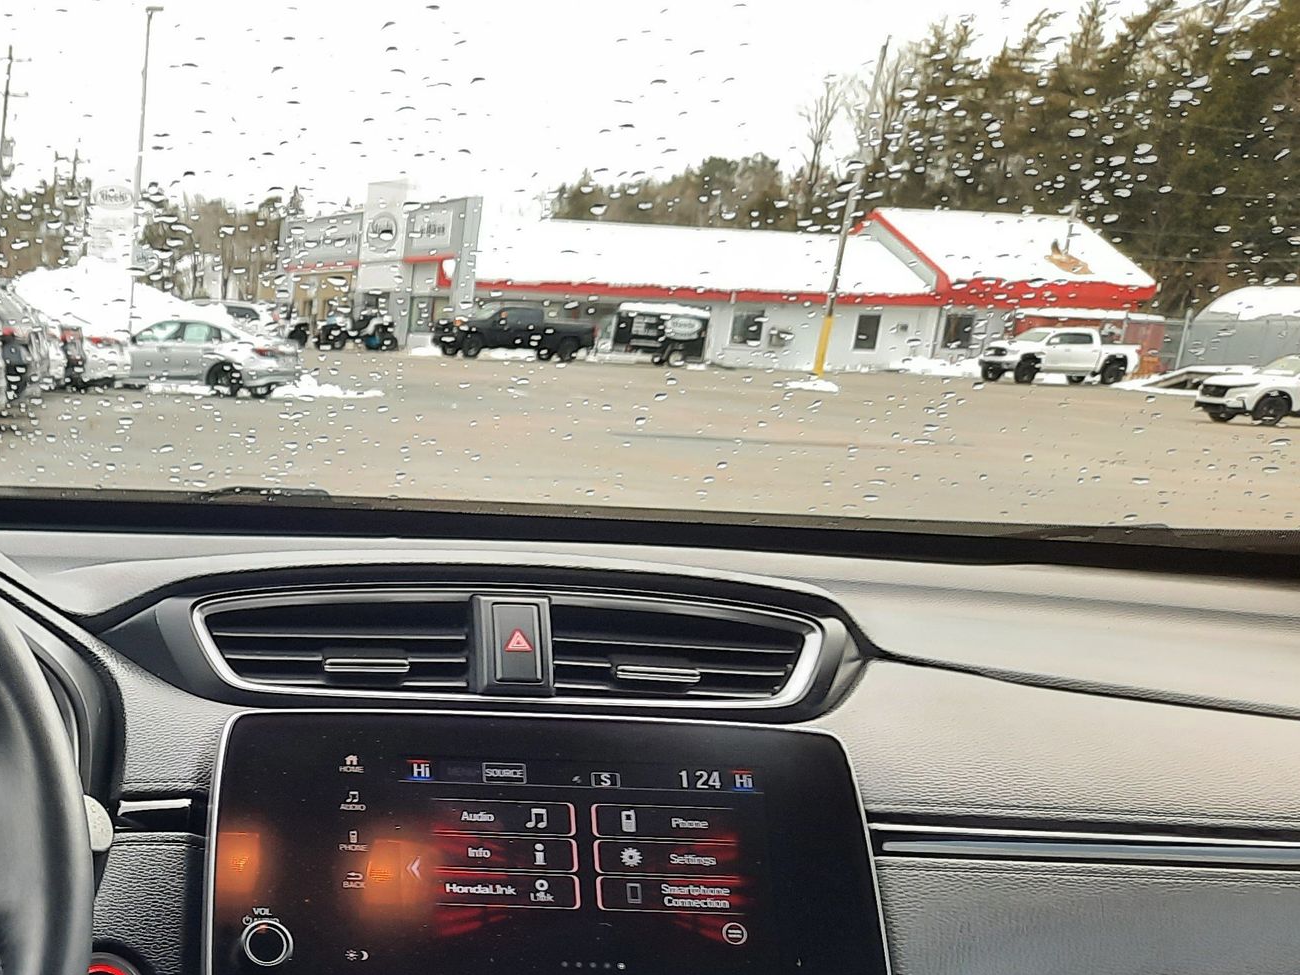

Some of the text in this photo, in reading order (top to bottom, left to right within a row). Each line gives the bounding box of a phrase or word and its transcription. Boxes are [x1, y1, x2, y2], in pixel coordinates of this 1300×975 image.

[339, 765, 365, 773] HOME
[413, 763, 431, 778] Hi
[485, 768, 524, 778] SOURCE
[735, 774, 753, 788] Hi
[340, 803, 366, 812] AUDIO
[460, 811, 495, 822] Audio
[671, 818, 709, 829] Phone
[467, 847, 491, 858] Info
[669, 854, 717, 866] Settings
[342, 880, 366, 889] BACK
[445, 883, 517, 896] HondaLink
[661, 883, 730, 896] Smartphone
[663, 896, 730, 909] Connection
[253, 907, 272, 917] VOL
